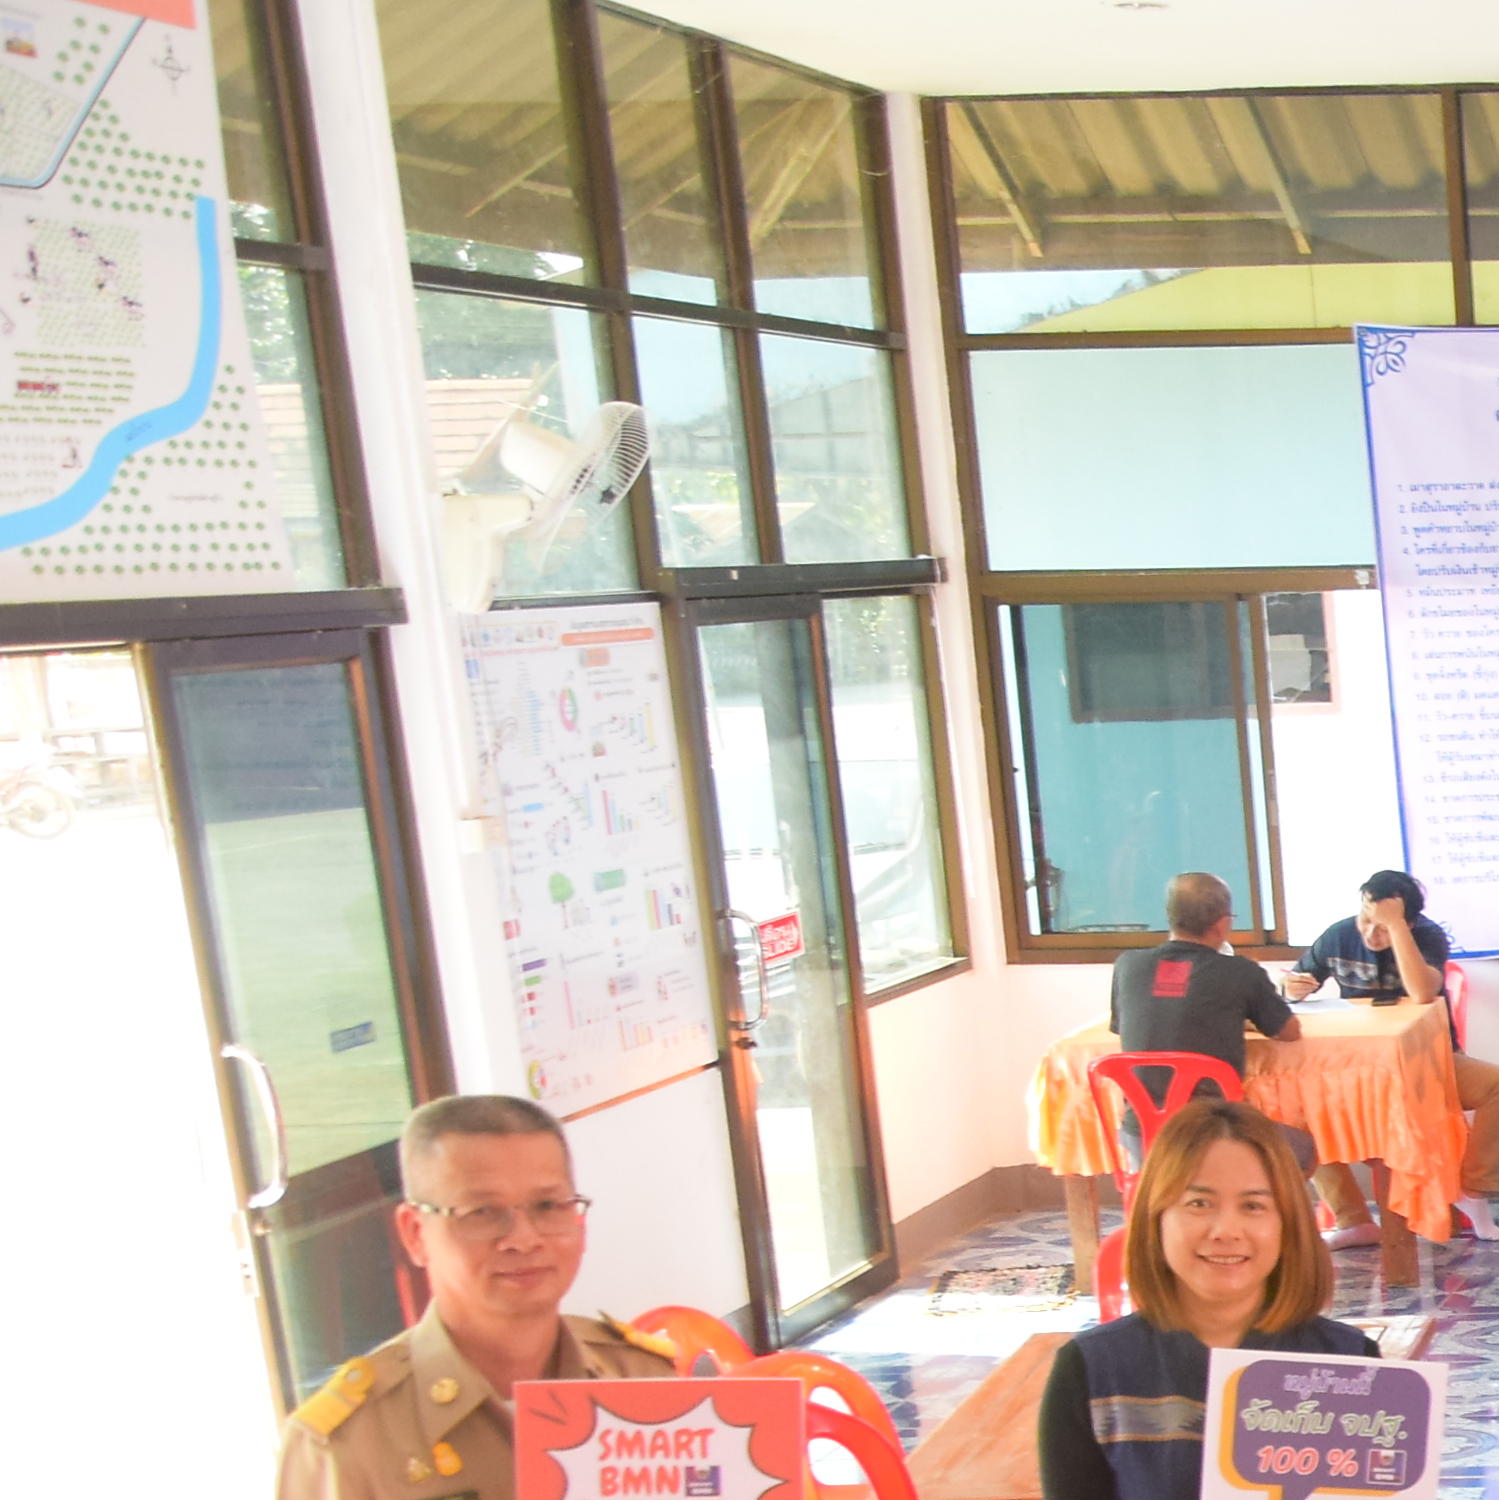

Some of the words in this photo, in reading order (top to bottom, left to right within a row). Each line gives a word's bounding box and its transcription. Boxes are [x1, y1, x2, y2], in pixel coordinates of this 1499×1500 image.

[1411, 499, 1482, 517] ยิงปืนในหมู่บ้าน
[1240, 1397, 1335, 1435] จัดเก็บ
[1339, 1410, 1409, 1447] จปฐ.
[598, 1427, 717, 1462] SMART
[1256, 1444, 1320, 1476] 100
[1326, 1447, 1360, 1477] %
[600, 1465, 681, 1497] BMN
